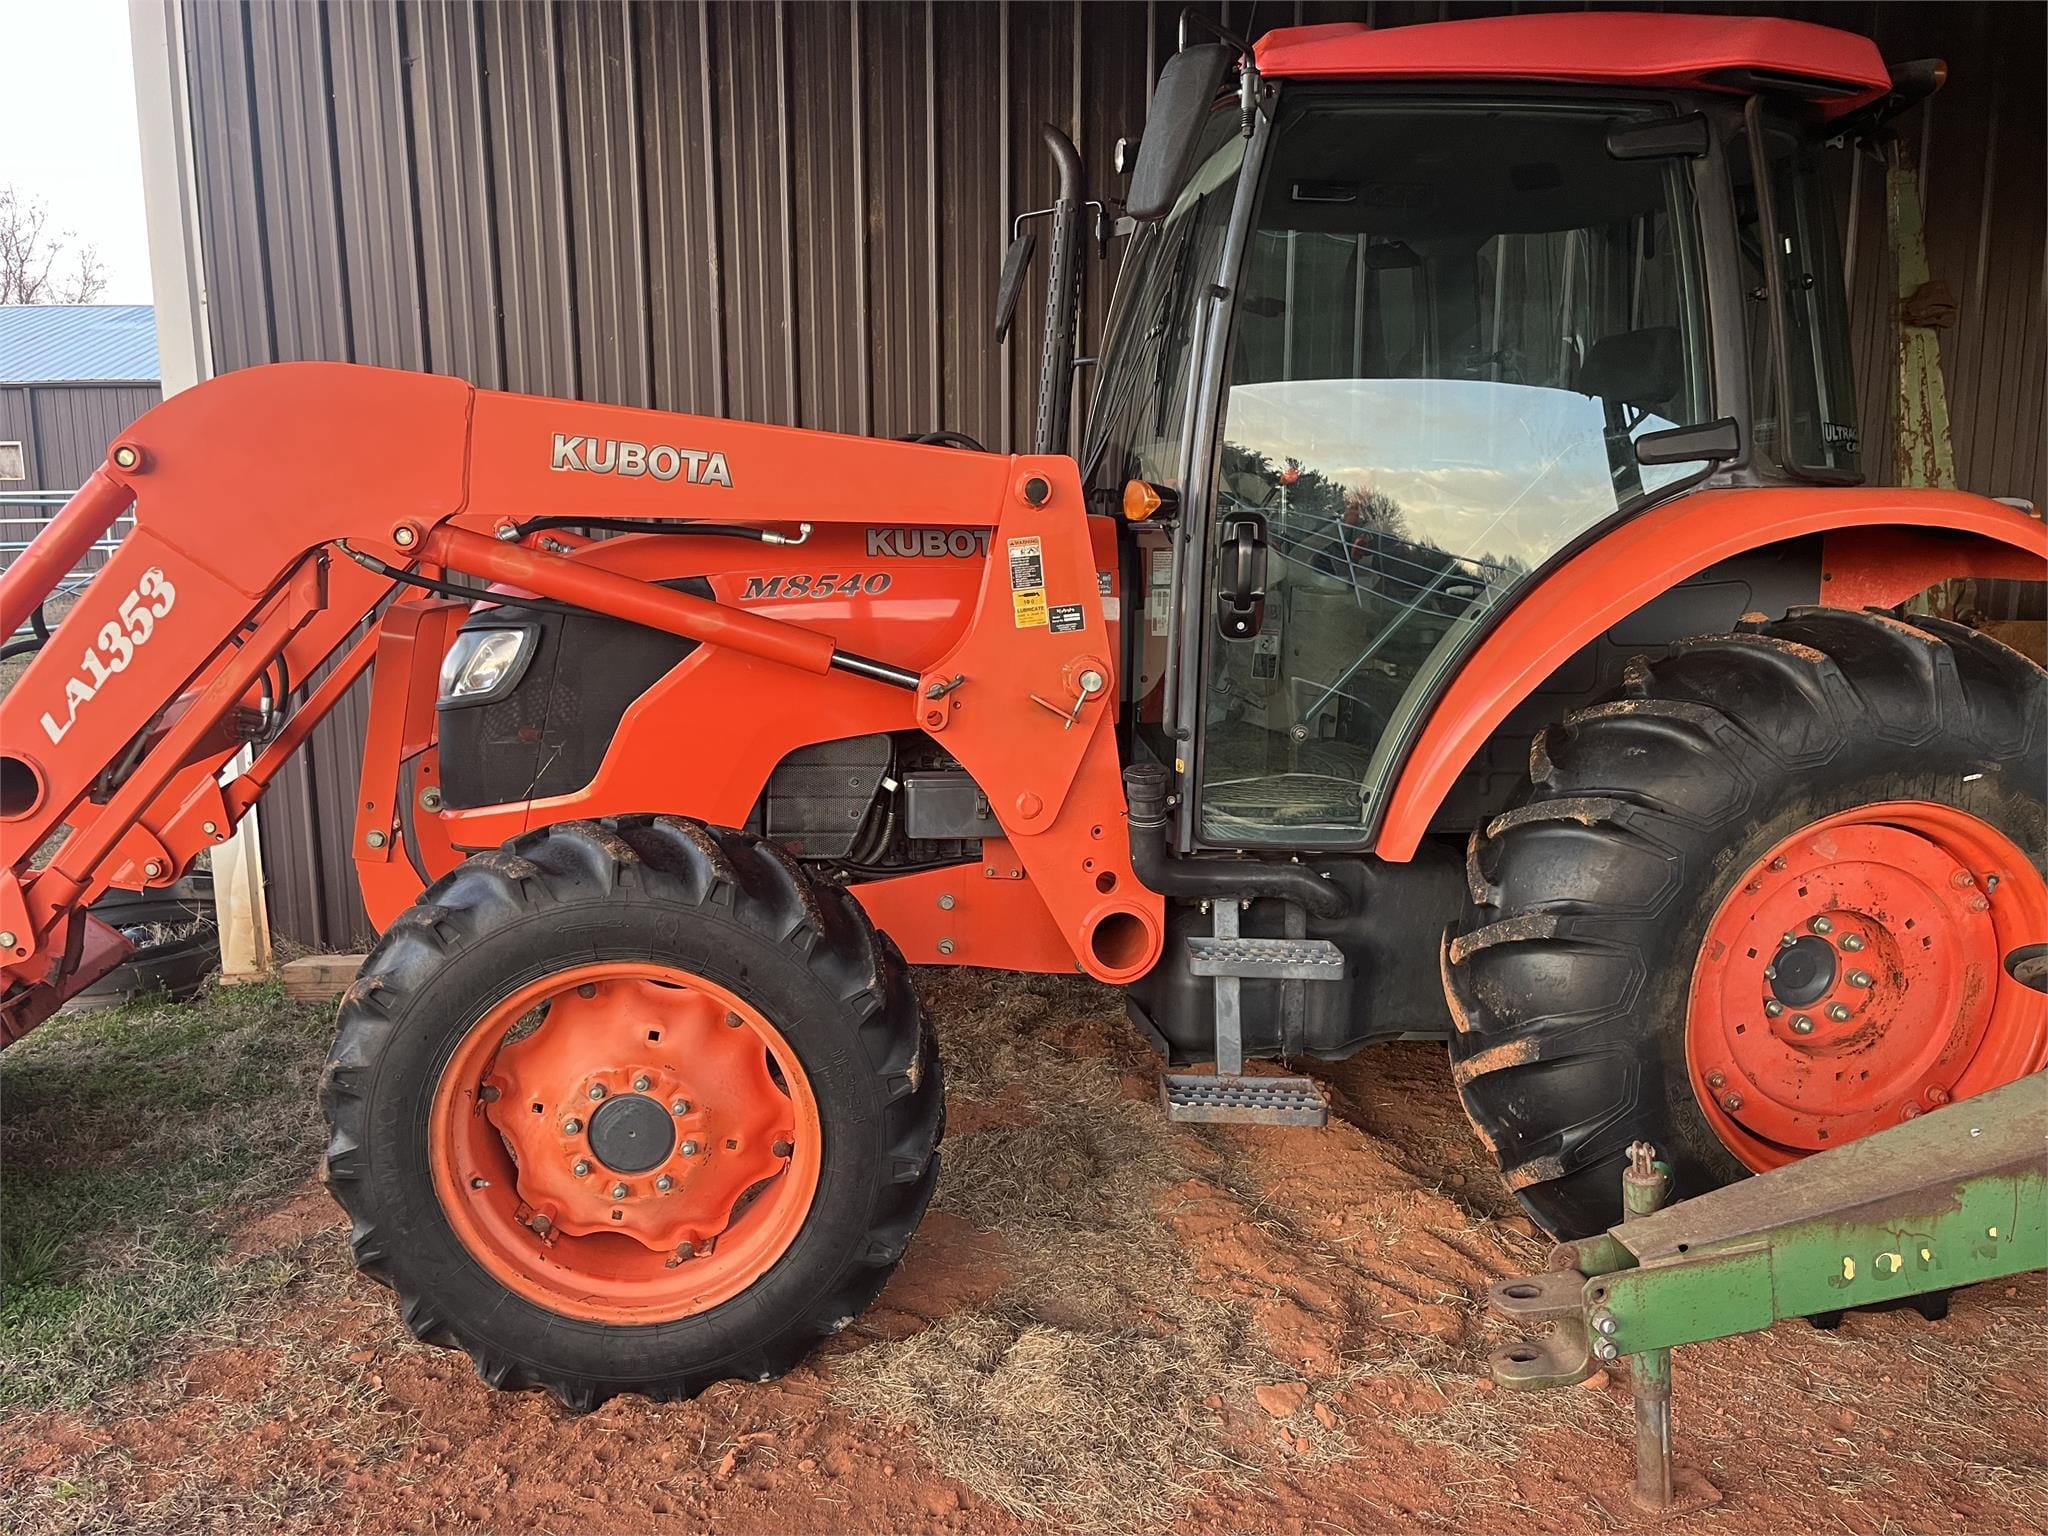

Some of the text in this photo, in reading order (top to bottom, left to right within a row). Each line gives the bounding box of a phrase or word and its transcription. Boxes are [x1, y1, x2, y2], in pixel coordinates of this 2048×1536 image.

[551, 433, 734, 488] KUBOTA
[739, 571, 892, 600] M8540
[40, 566, 175, 745] LA1353
